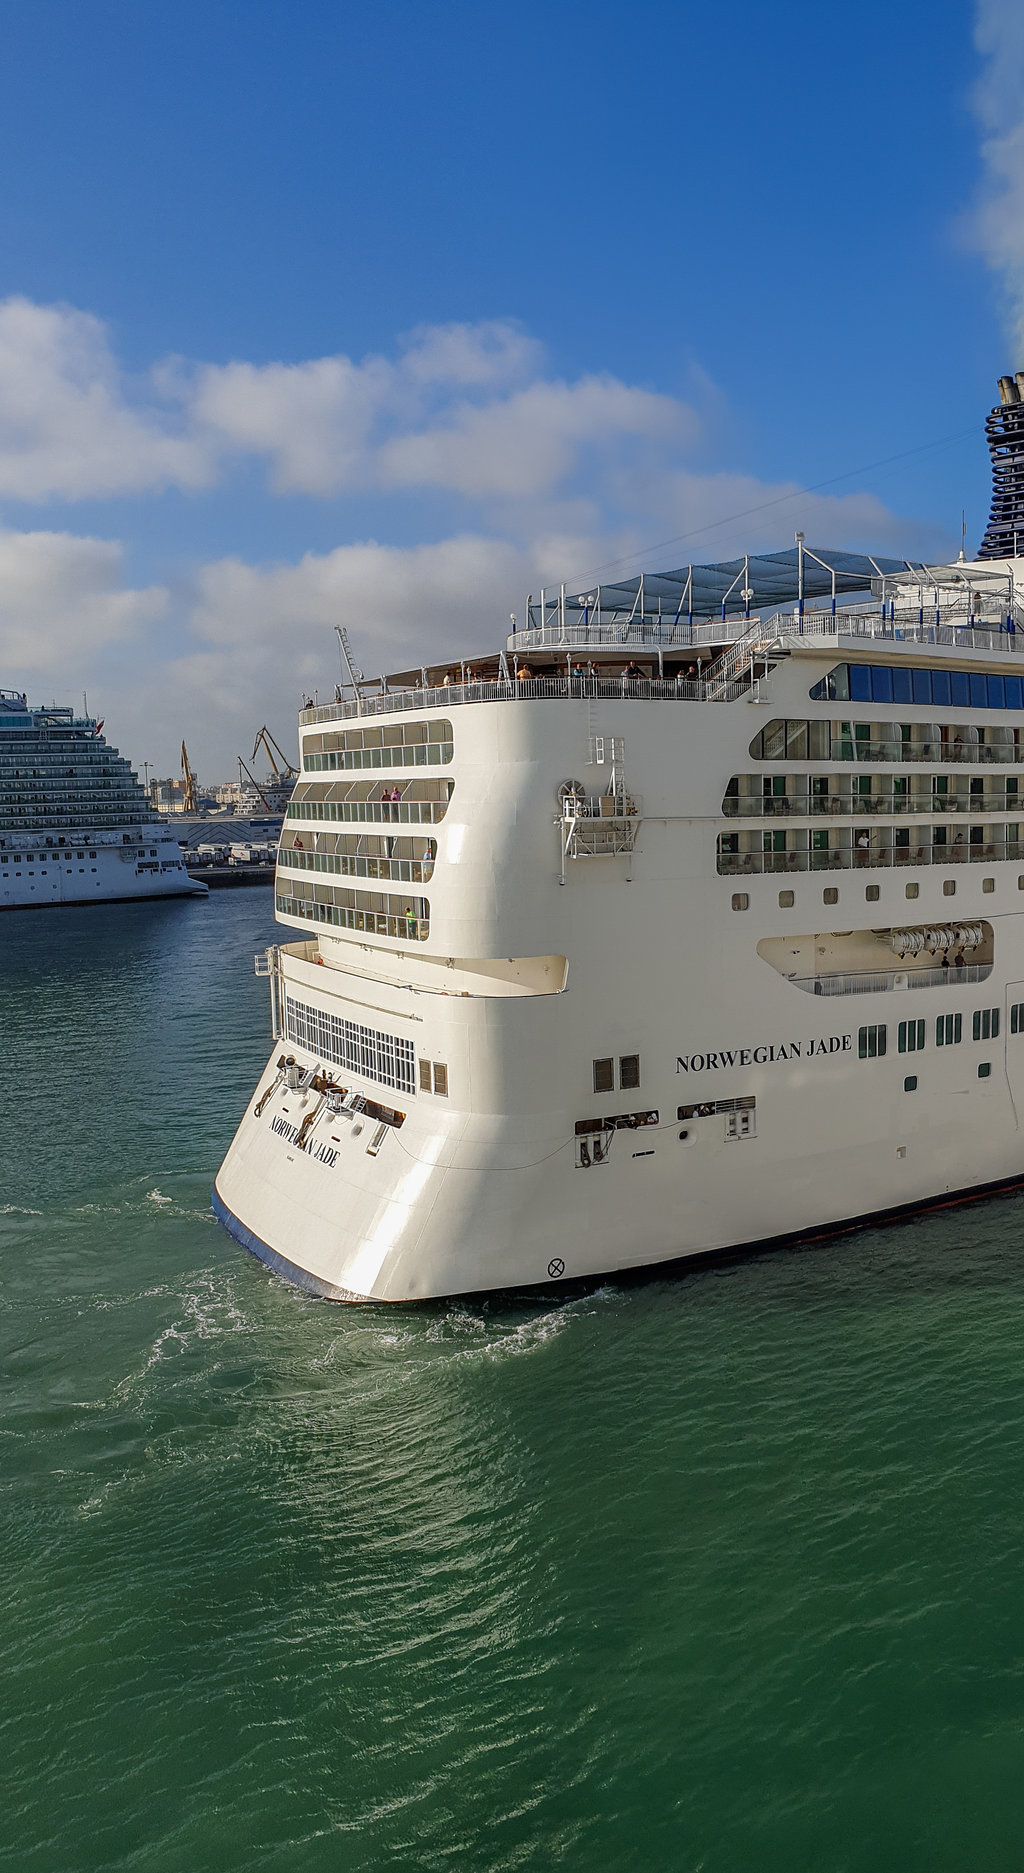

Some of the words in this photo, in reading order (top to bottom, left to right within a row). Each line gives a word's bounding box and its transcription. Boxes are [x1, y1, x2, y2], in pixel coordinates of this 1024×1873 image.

[675, 1042, 801, 1074] NORWEGIAN
[806, 1035, 852, 1057] JADE
[314, 1143, 341, 1168] JADE
